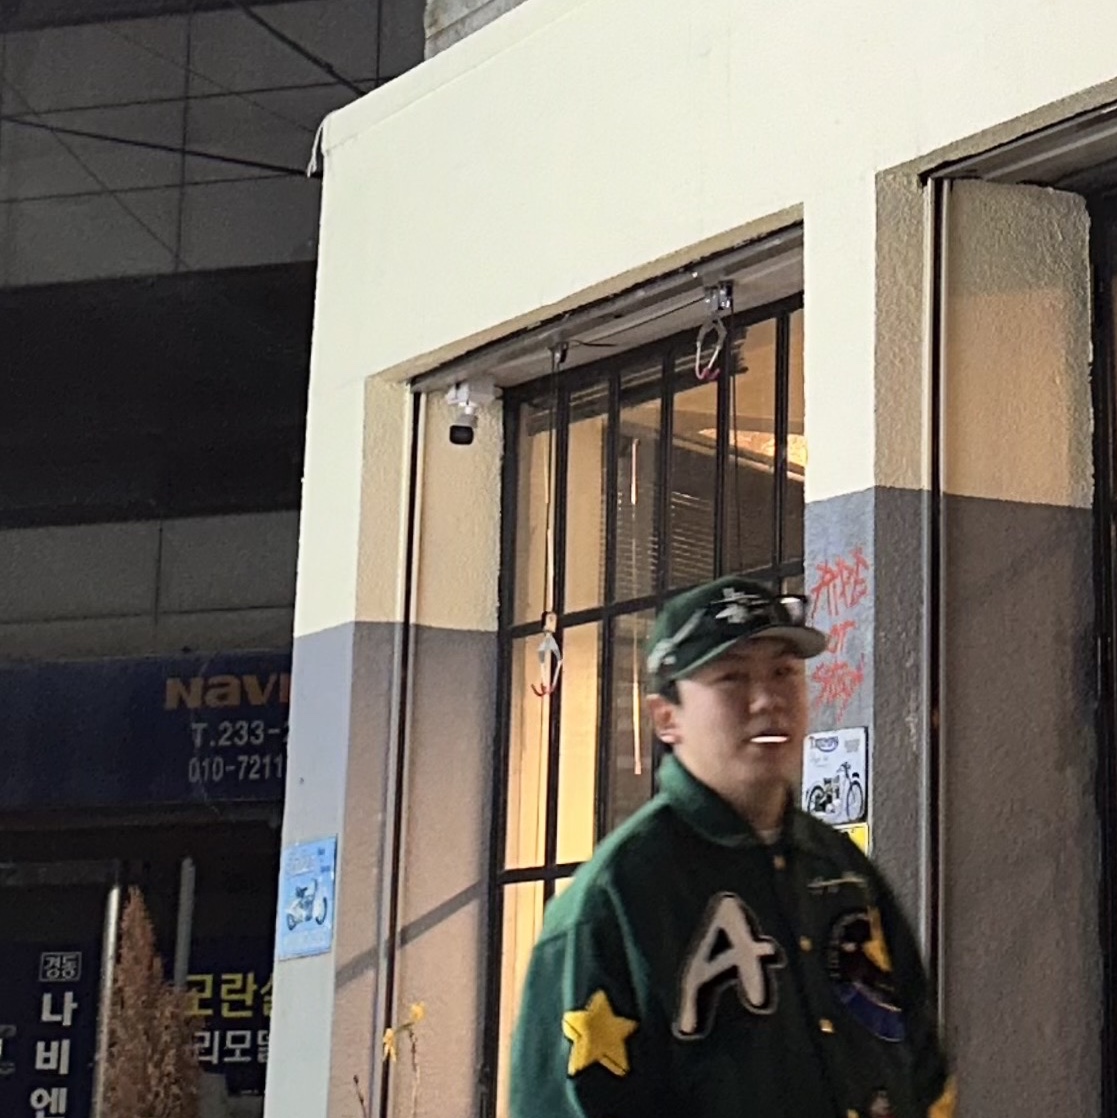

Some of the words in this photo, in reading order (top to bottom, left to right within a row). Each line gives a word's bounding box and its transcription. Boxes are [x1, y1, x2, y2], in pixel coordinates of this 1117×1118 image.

[188, 754, 284, 783] 010-7211
[44, 954, 77, 979] 경동
[675, 893, 784, 1038] A
